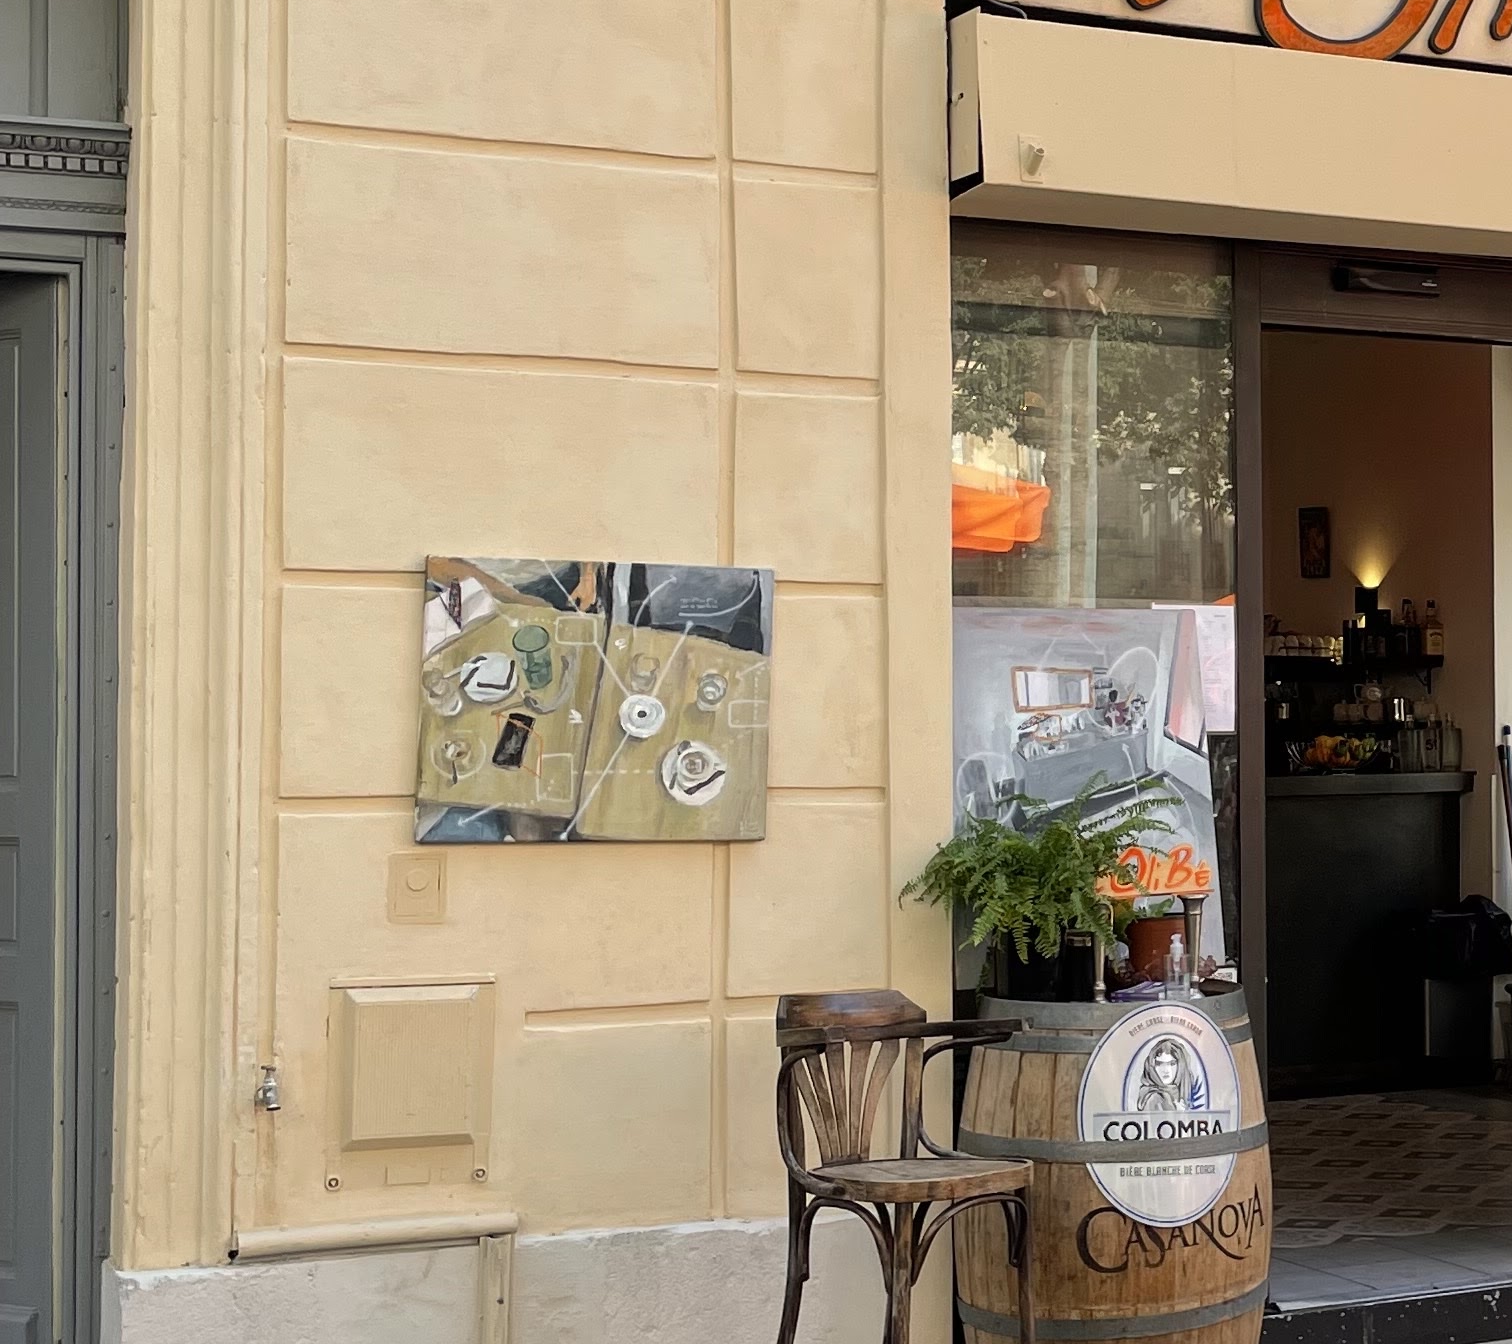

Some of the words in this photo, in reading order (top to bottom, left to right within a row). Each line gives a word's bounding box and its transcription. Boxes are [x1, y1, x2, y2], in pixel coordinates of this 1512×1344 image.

[1103, 1119, 1223, 1142] COLOMBA
[1120, 1164, 1144, 1177] BIÈRE
[1146, 1165, 1181, 1176] BLANCHE
[1183, 1164, 1193, 1175] DE
[1195, 1164, 1216, 1175] CORSE
